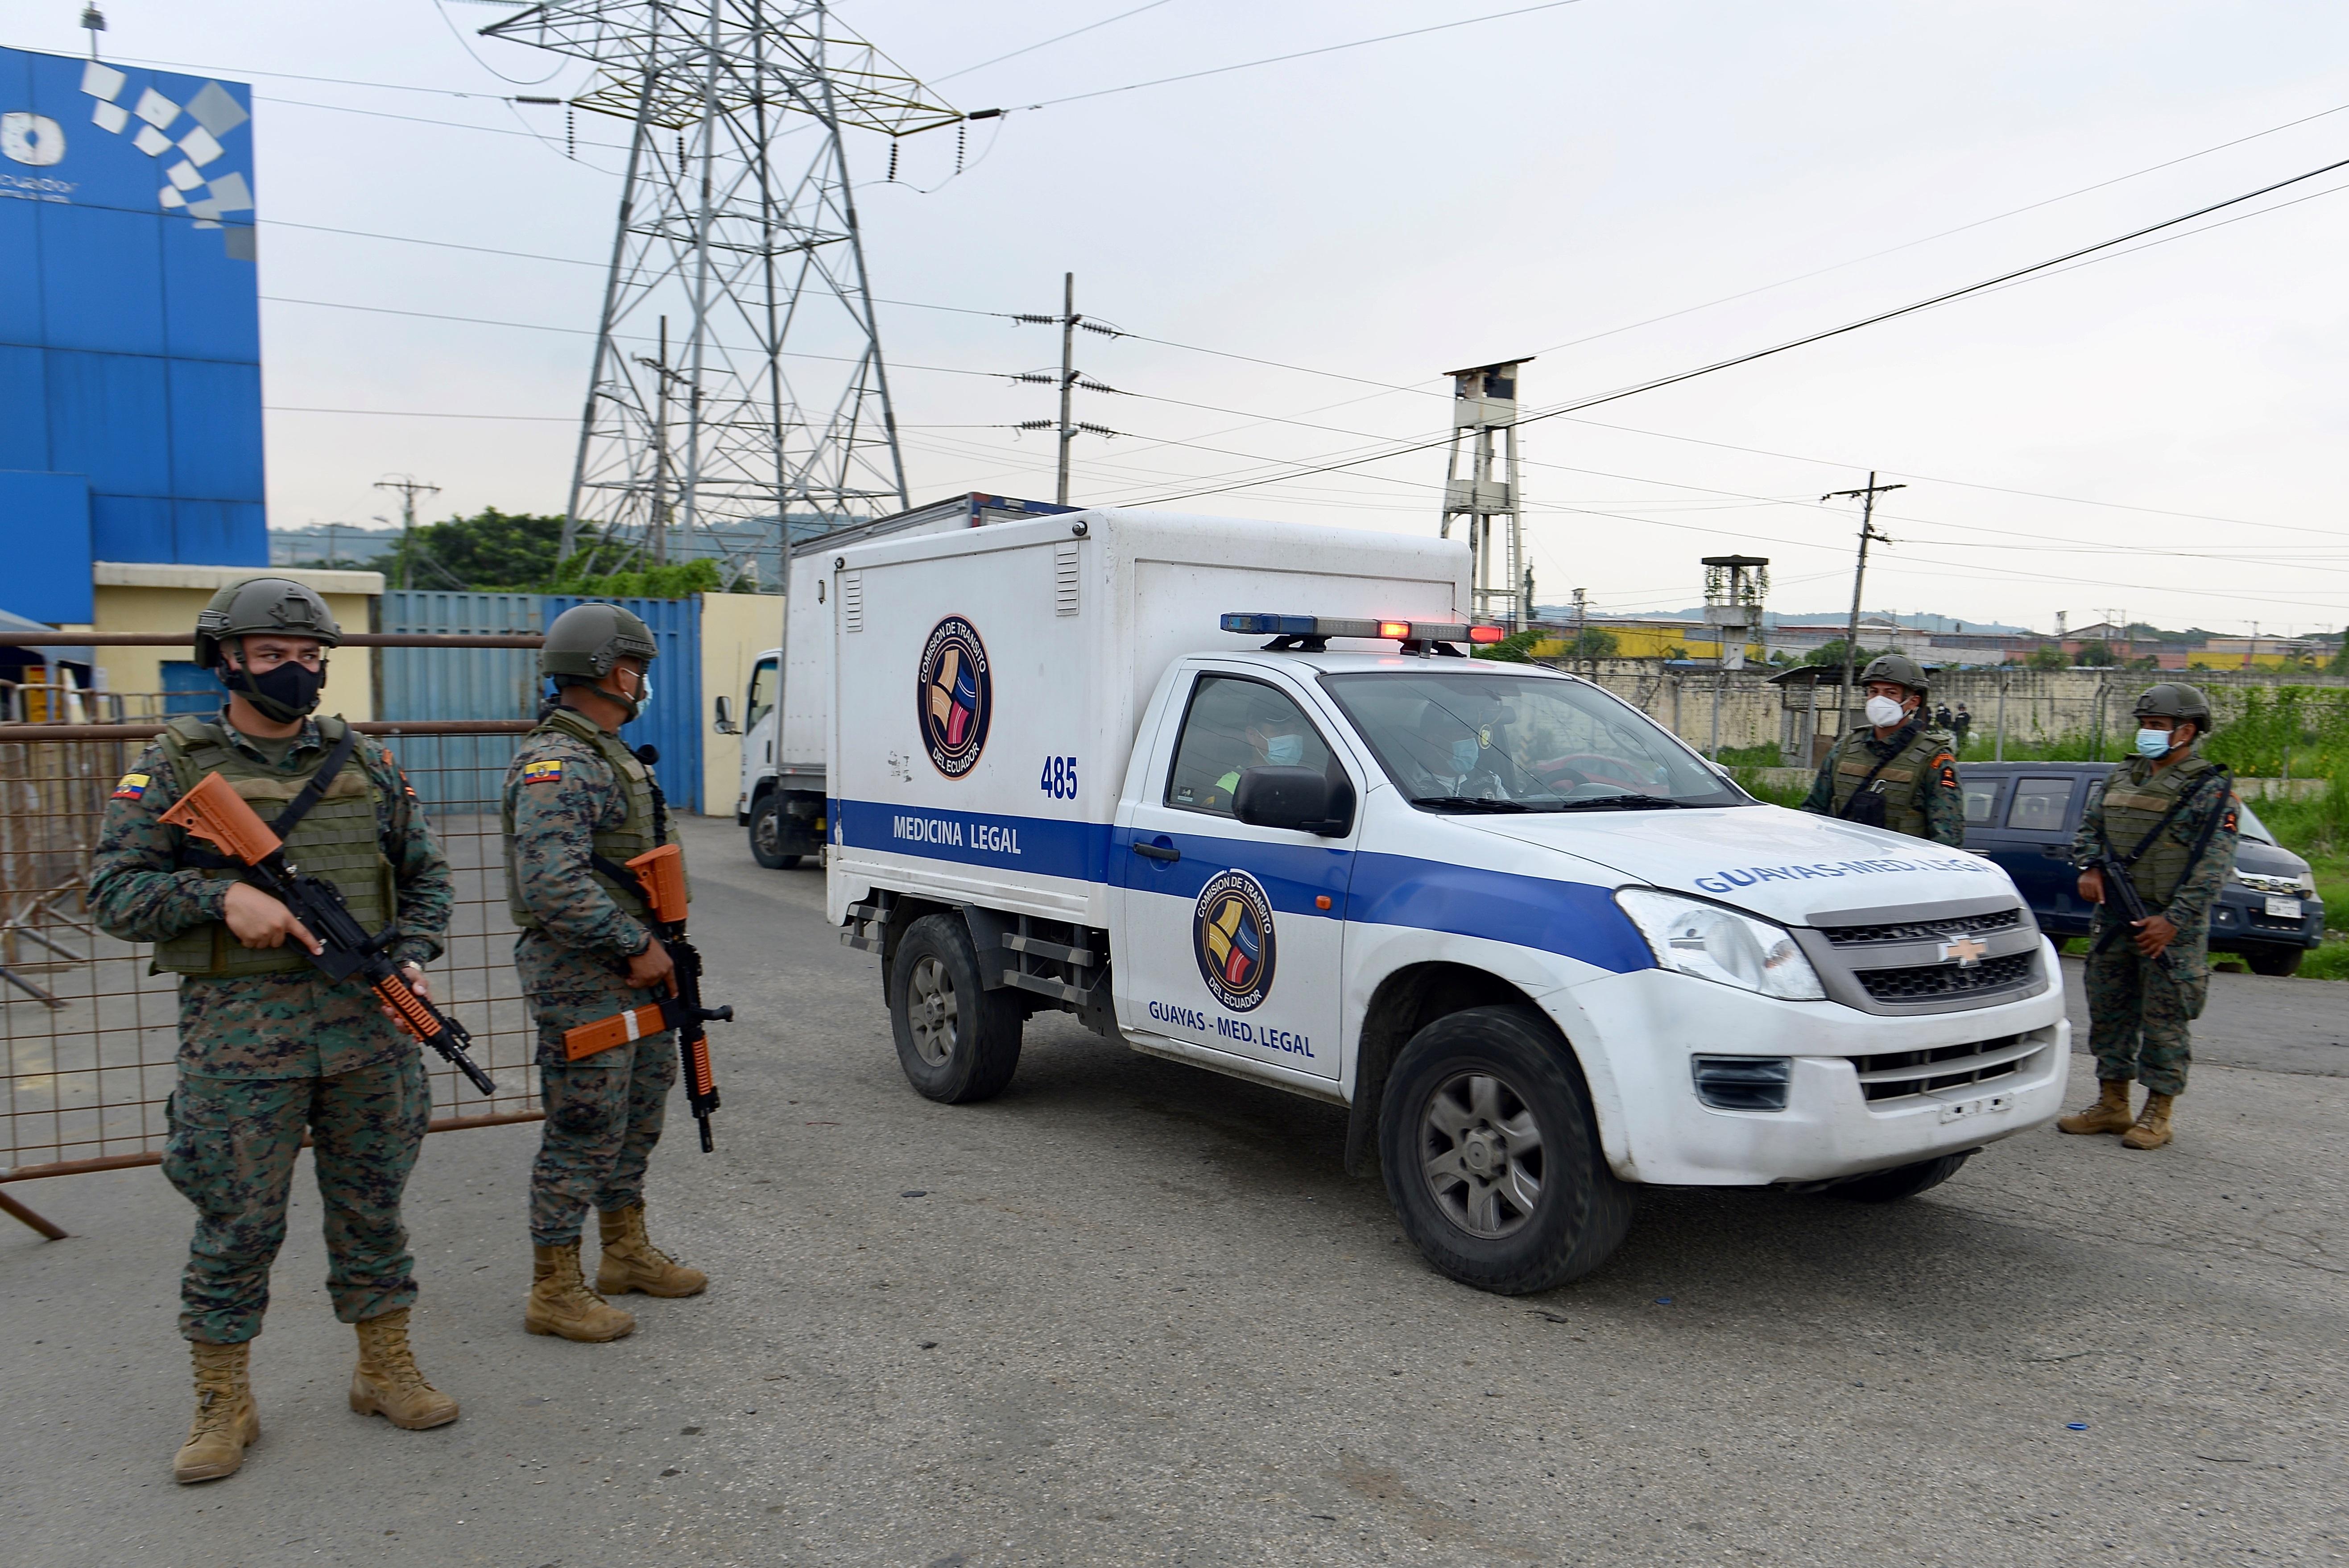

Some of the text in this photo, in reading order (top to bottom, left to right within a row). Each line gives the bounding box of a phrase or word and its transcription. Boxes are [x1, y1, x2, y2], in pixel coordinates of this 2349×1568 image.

[921, 621, 986, 683] COMISION DE TRANSITO
[933, 742, 980, 773] DEL ECUADOR
[1041, 755, 1078, 800] 485
[893, 815, 1021, 854] MEDICINA LEGAL
[1913, 859, 2000, 875] LEGA
[1198, 876, 1272, 934] COMISION DE TRANSITO
[1208, 976, 1262, 1008] DEL ECUADOR
[1149, 1001, 1205, 1031] GUAYAS
[1217, 1017, 1257, 1044] MED.
[1260, 1026, 1315, 1059] LEGAL
